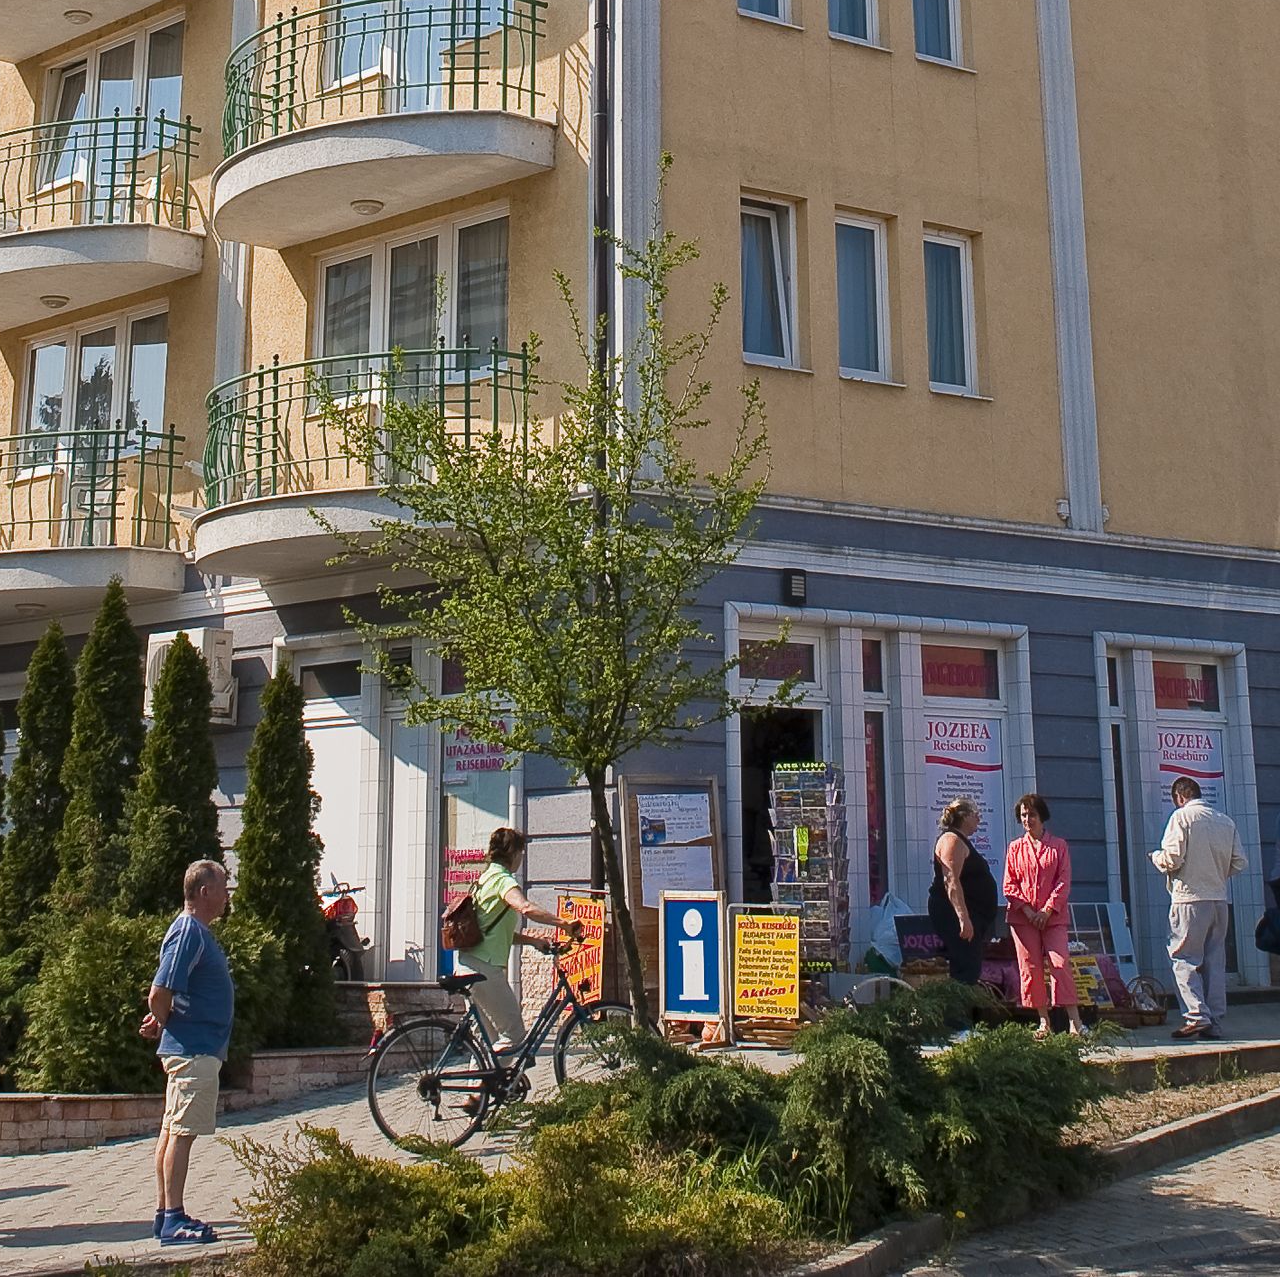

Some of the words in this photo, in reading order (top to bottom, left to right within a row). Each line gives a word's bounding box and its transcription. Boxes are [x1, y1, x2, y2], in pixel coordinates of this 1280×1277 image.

[925, 721, 991, 740] JOZEFA
[933, 740, 986, 752] Reisebüro
[1158, 733, 1213, 750] JOZEFA
[1162, 749, 1209, 762] Reisebüro
[455, 755, 505, 771] REISEBÜRO
[573, 904, 602, 920] JOZEFA
[743, 931, 775, 939] BUDAPEST
[739, 986, 786, 999] Aktion
